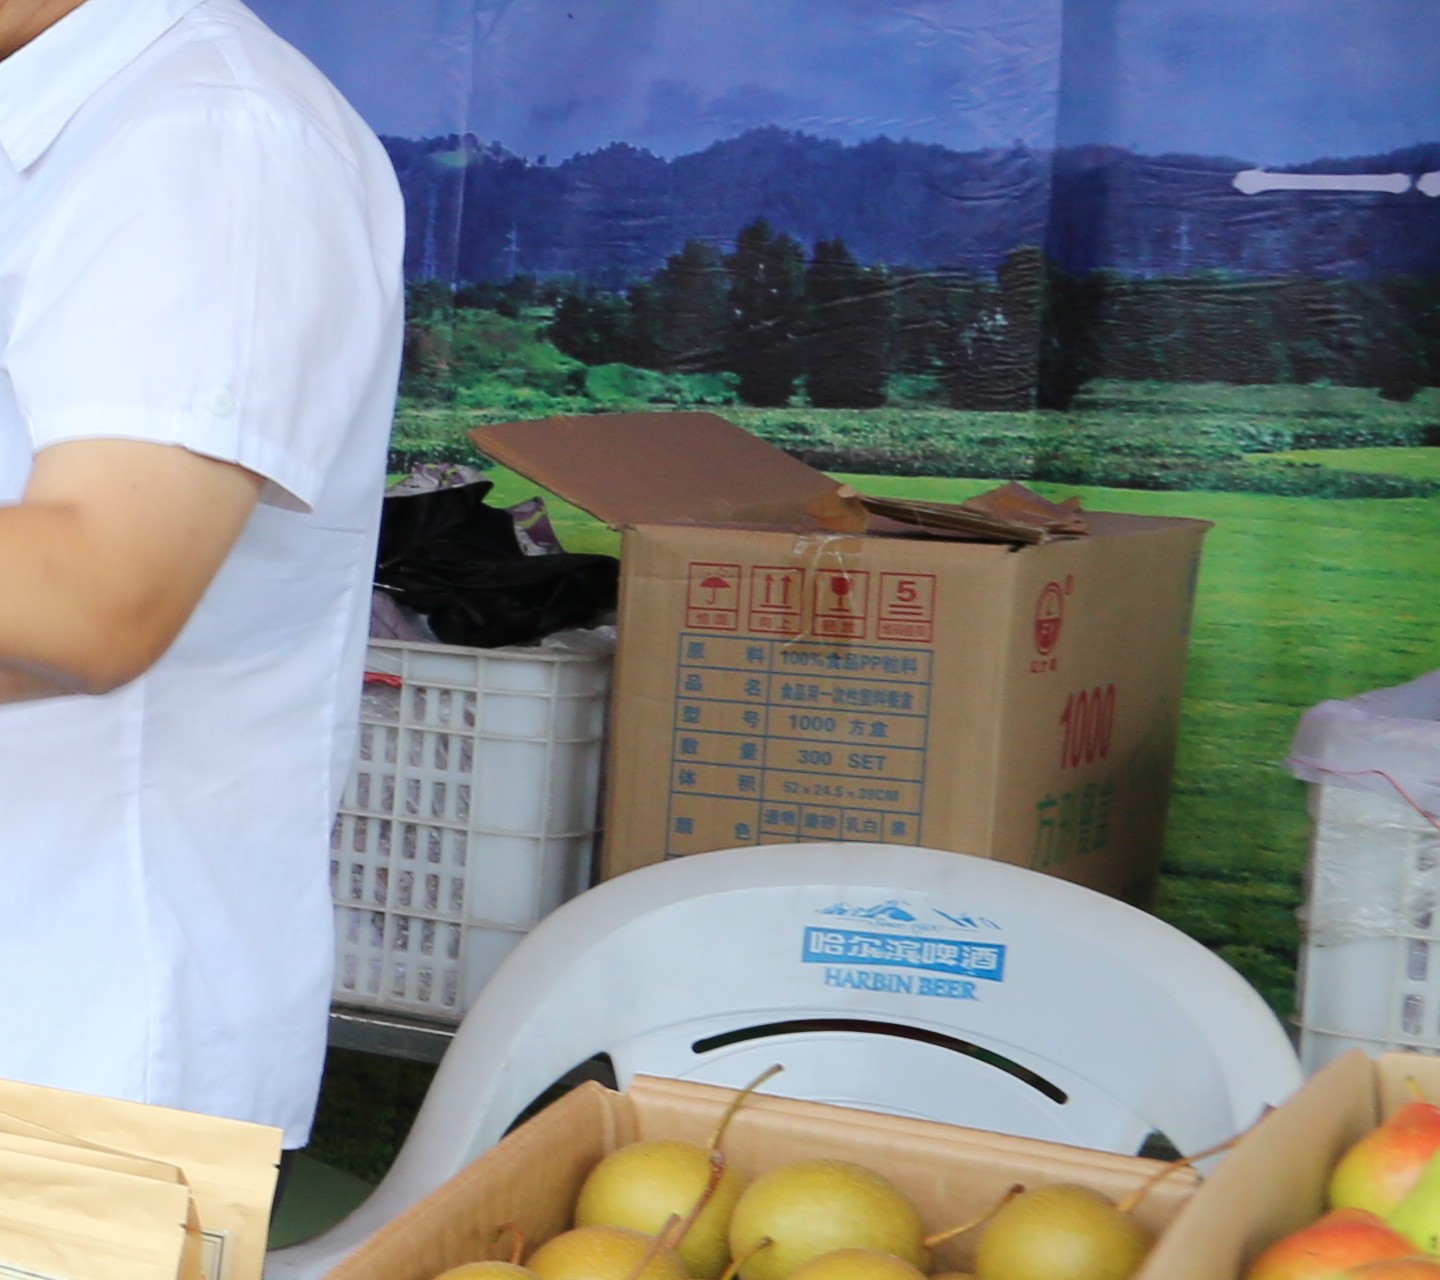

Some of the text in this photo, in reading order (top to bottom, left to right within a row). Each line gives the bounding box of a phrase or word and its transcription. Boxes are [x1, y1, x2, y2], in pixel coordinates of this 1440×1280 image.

[897, 581, 917, 603] 5
[789, 714, 836, 732] 1000
[1061, 683, 1116, 768] 1000
[798, 750, 832, 766] 300
[848, 754, 887, 770] SET
[810, 931, 998, 970] 哈尔滨啤酒
[919, 977, 980, 1001] BEER
